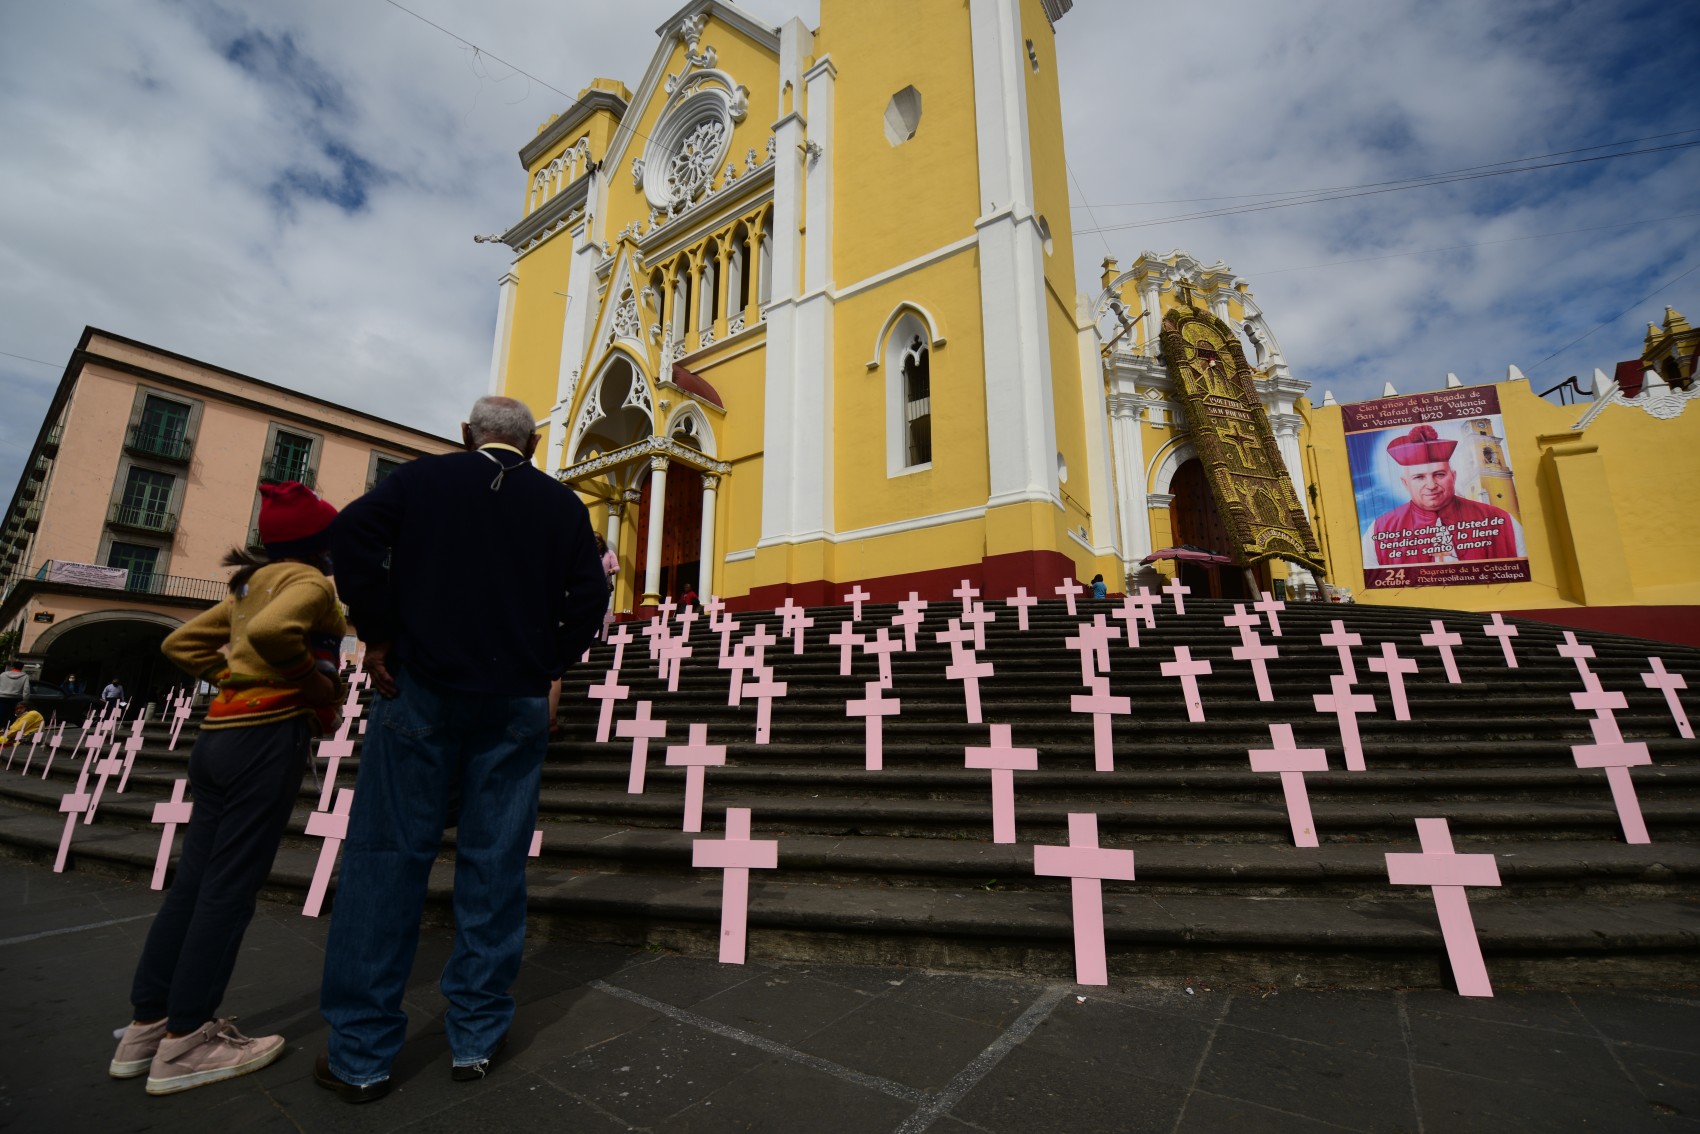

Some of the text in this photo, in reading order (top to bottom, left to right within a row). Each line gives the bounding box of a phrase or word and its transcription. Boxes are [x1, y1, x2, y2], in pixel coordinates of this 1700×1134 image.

[1359, 404, 1378, 412] Cien
[1407, 398, 1418, 406] de
[1433, 393, 1466, 403] llegada
[1380, 407, 1409, 418] Rafael
[1447, 399, 1487, 409] Valencia
[1372, 416, 1413, 426] Veracruz
[1421, 411, 1444, 421] 1920
[1456, 406, 1483, 416] 2020
[1372, 531, 1401, 541] «Dios
[1402, 528, 1412, 537] lo
[1414, 525, 1447, 536] colme
[1457, 517, 1489, 530] Usted
[1490, 516, 1505, 526] de
[1380, 529, 1499, 550] bendiciones y lo llene
[1388, 540, 1492, 559] de su santo amor»
[1385, 568, 1406, 581] 24
[1417, 574, 1475, 584] Metropolitana
[1492, 572, 1524, 580] Xalapa
[1420, 567, 1456, 576] Sagrario
[1483, 563, 1520, 572] Catedral
[1374, 578, 1411, 587] Octubre
